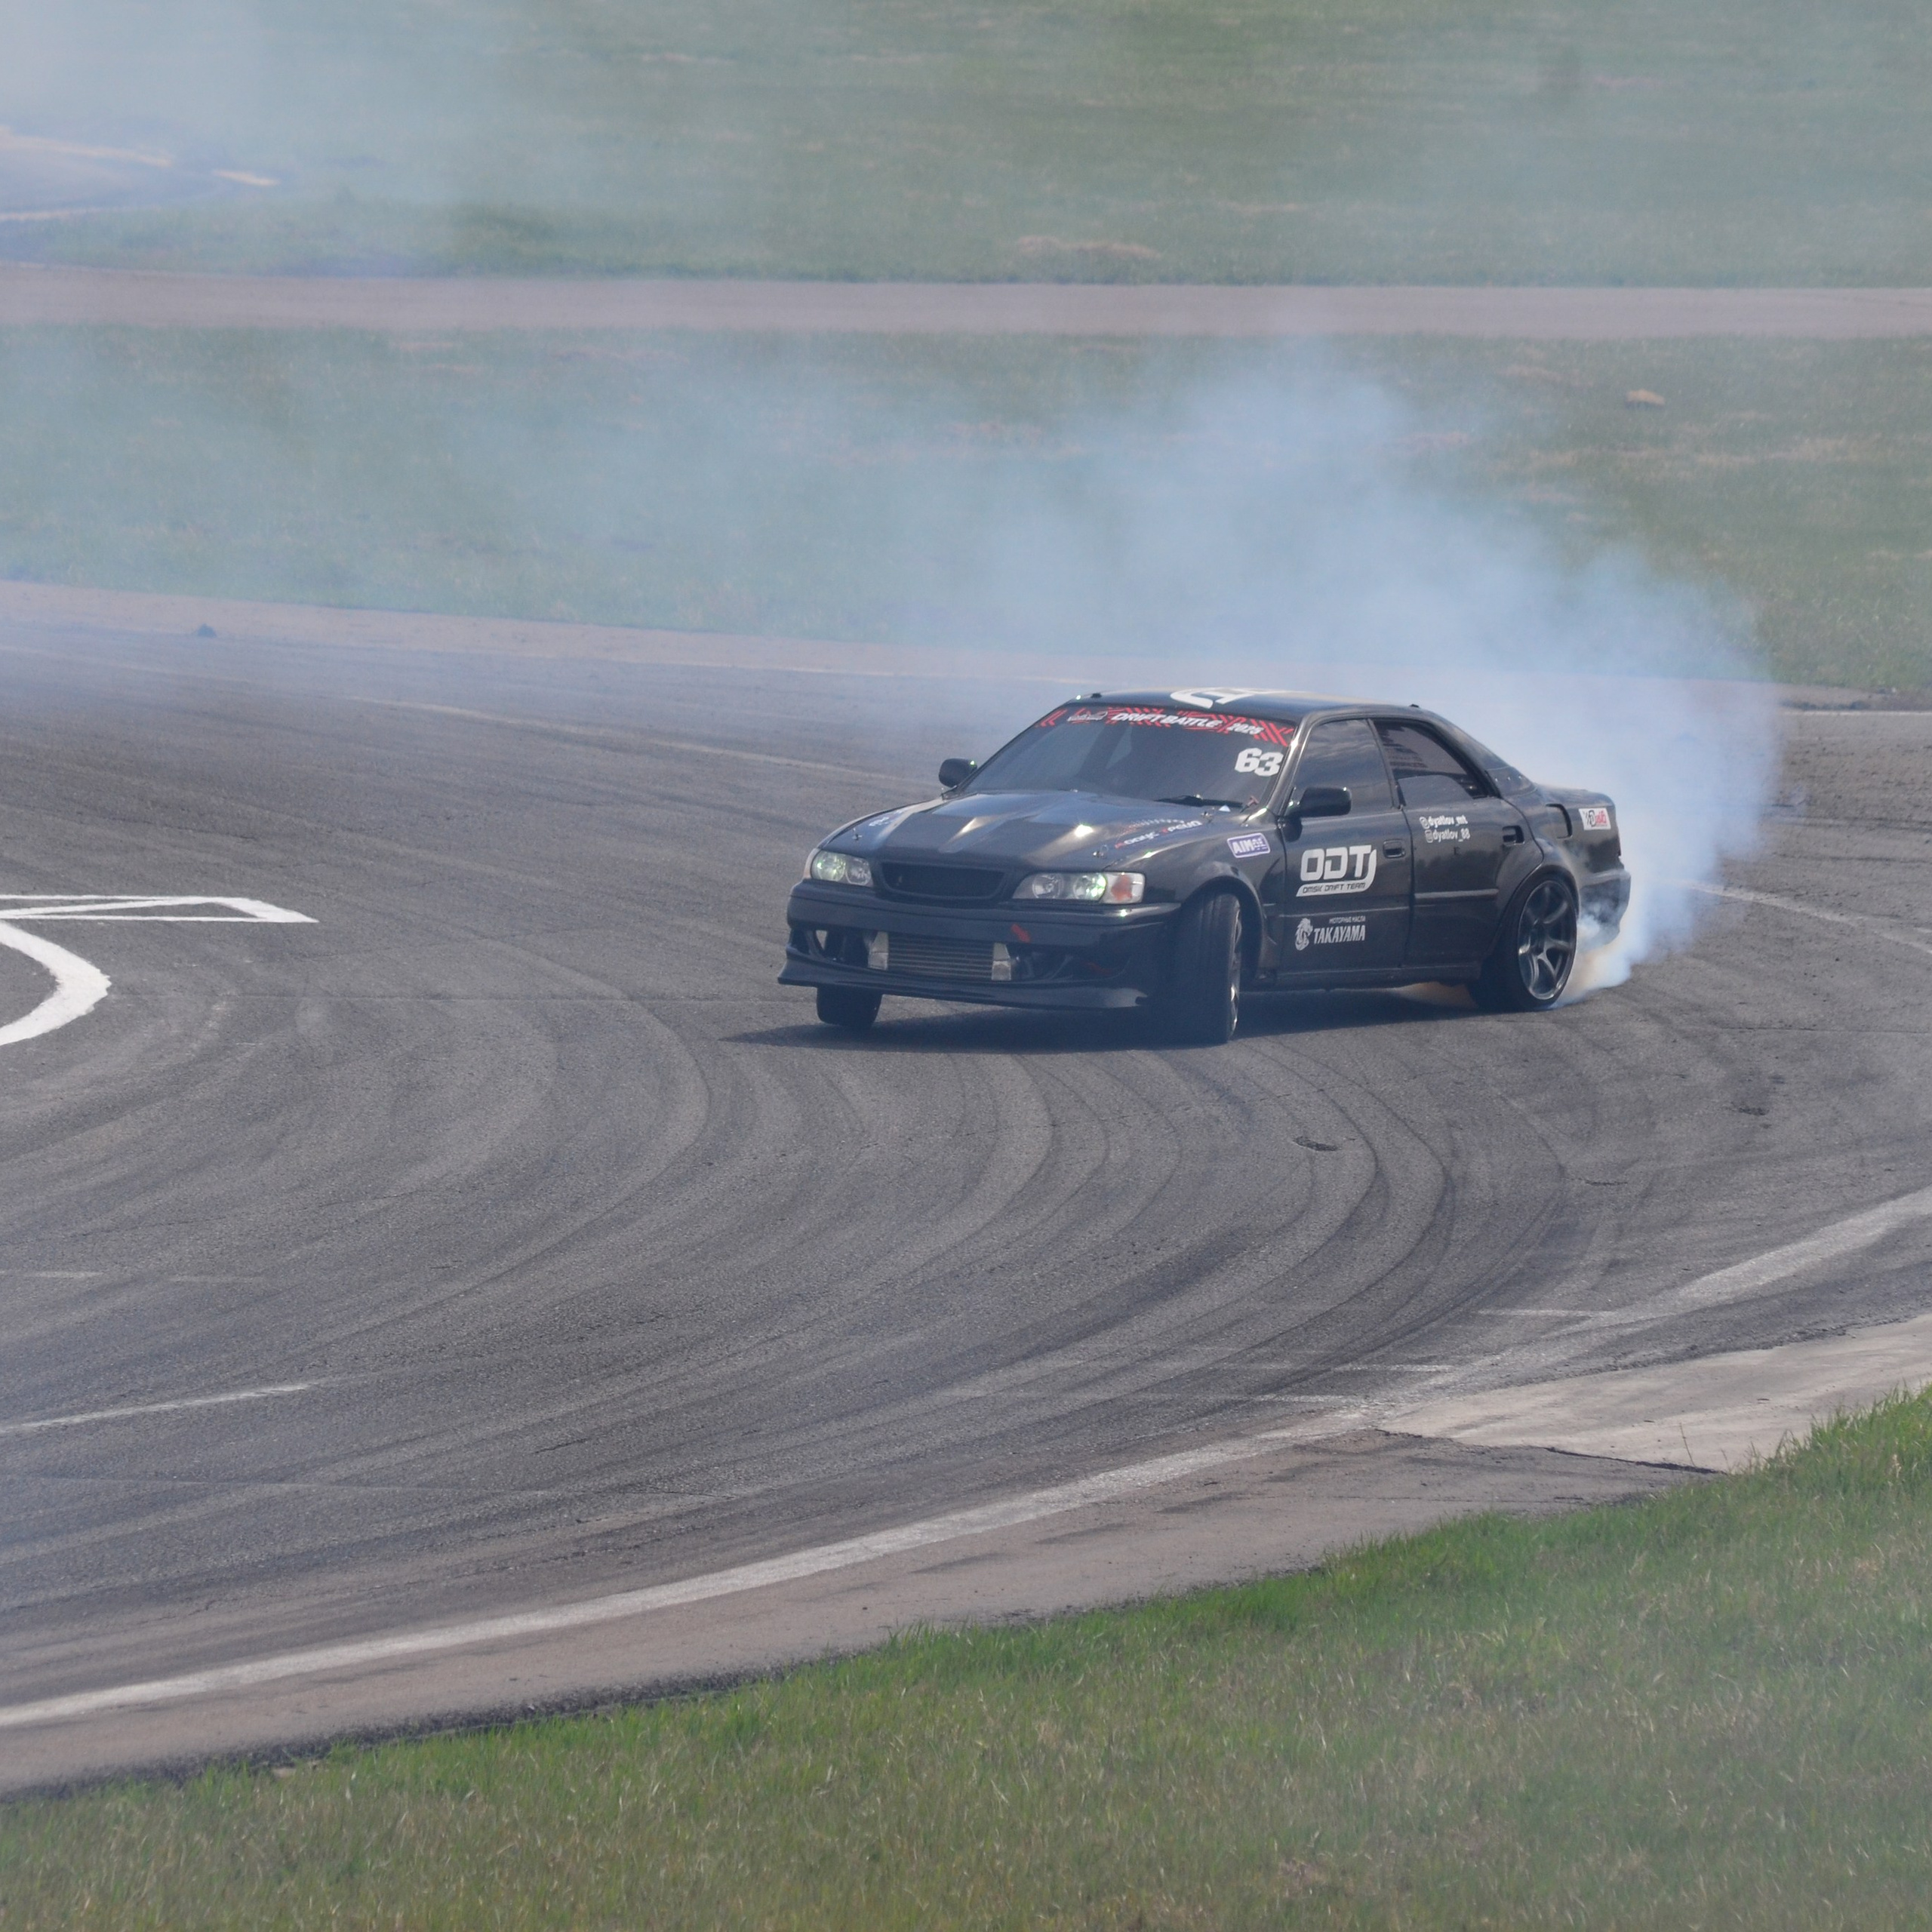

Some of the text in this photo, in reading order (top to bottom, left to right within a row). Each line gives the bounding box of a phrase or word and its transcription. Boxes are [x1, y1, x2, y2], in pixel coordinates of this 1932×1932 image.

[1111, 712, 1167, 722] DRIFT
[1160, 715, 1223, 728] BATTLE
[1227, 722, 1265, 735] 2025
[1235, 747, 1284, 777] 63
[1300, 844, 1372, 881] ODT
[1303, 885, 1323, 894] OMSK
[1313, 924, 1366, 944] TAKAYAMA
